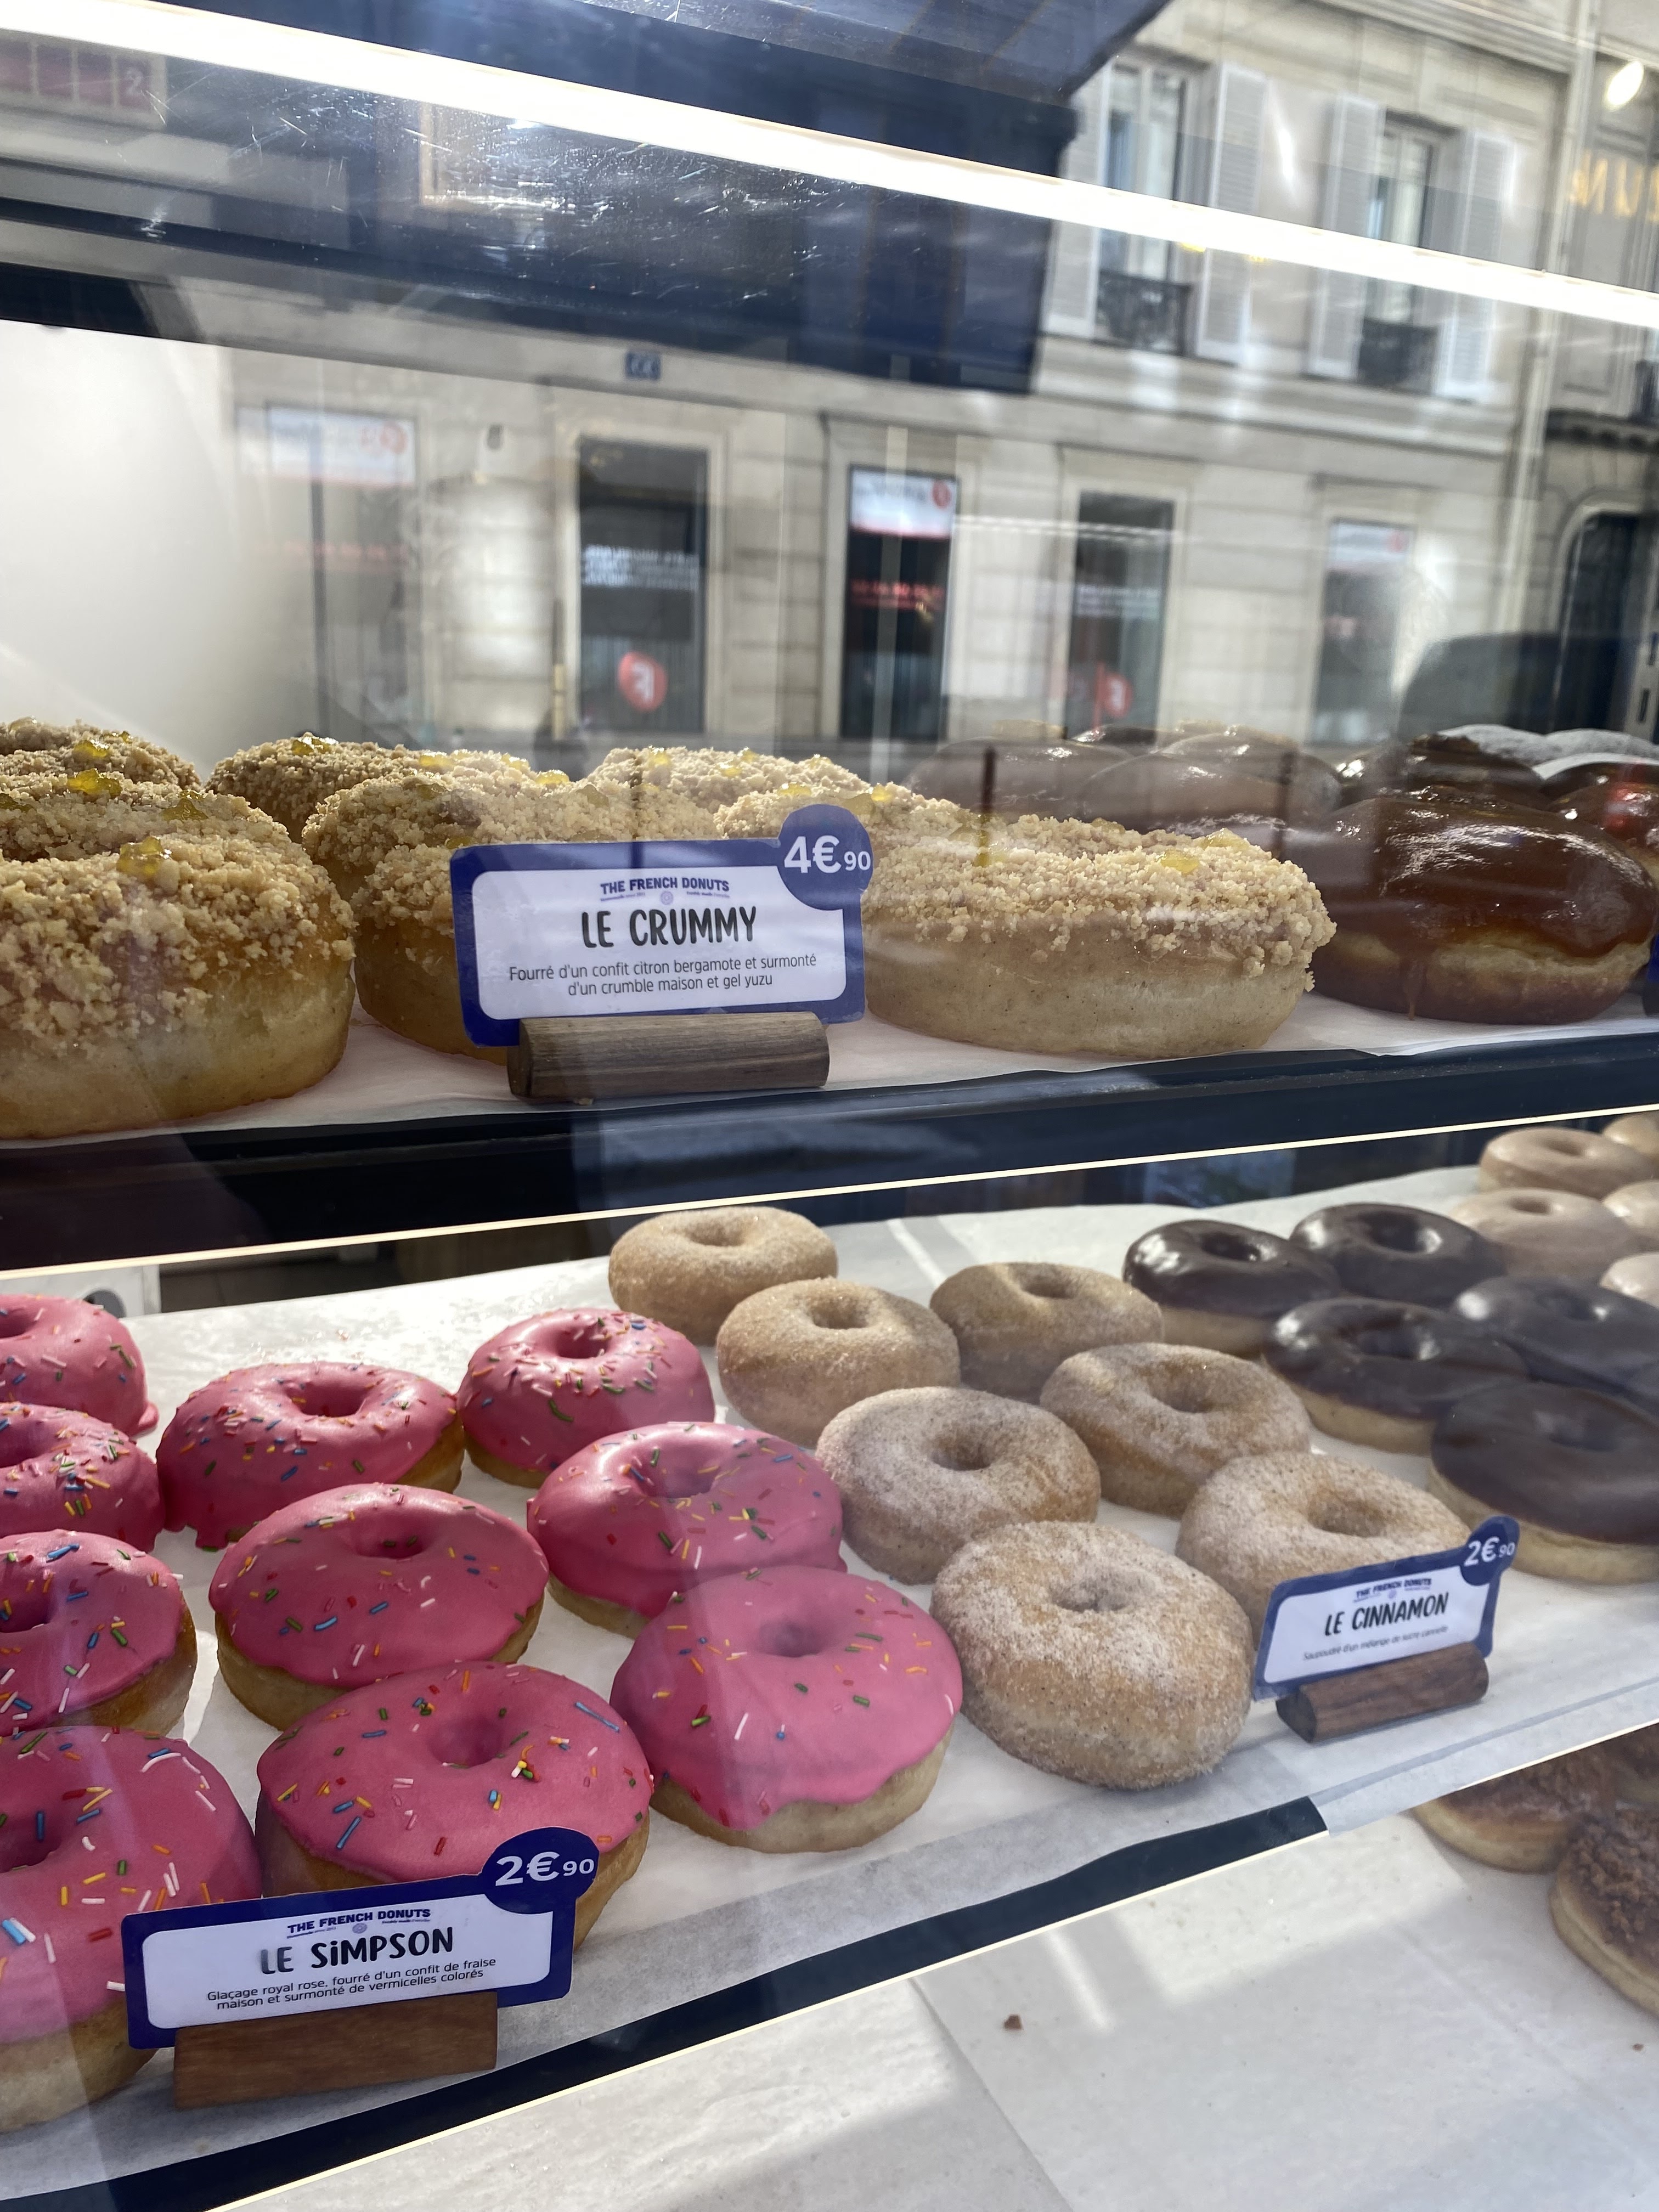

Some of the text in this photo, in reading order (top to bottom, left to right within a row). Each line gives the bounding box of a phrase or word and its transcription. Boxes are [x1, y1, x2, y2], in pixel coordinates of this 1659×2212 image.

[600, 877, 730, 894] THE FRENCH DONUTS
[582, 906, 756, 948] LE CRUMMY
[510, 953, 816, 980] Fourré d'un confit citron bergamote et surmonté
[568, 974, 772, 996] d'un crumble maison et gel yuzu
[1373, 1581, 1402, 1592] FRENCH
[1325, 1592, 1449, 1636] LE CINNAMON
[287, 1921, 315, 1933] THE
[319, 1912, 373, 1927] FRENCH
[377, 1909, 431, 1920] DONUTS
[260, 1946, 294, 1974] LE
[207, 1988, 258, 2001] Glaçage
[263, 1983, 293, 1995] royal
[332, 1974, 370, 1985] fourré
[375, 1971, 401, 1980] d'un
[405, 1965, 440, 1977] confit
[444, 1962, 459, 1972] de
[464, 1959, 496, 1970] fraise
[217, 1969, 483, 2010] maison et surmonté de vermicelles colorés
